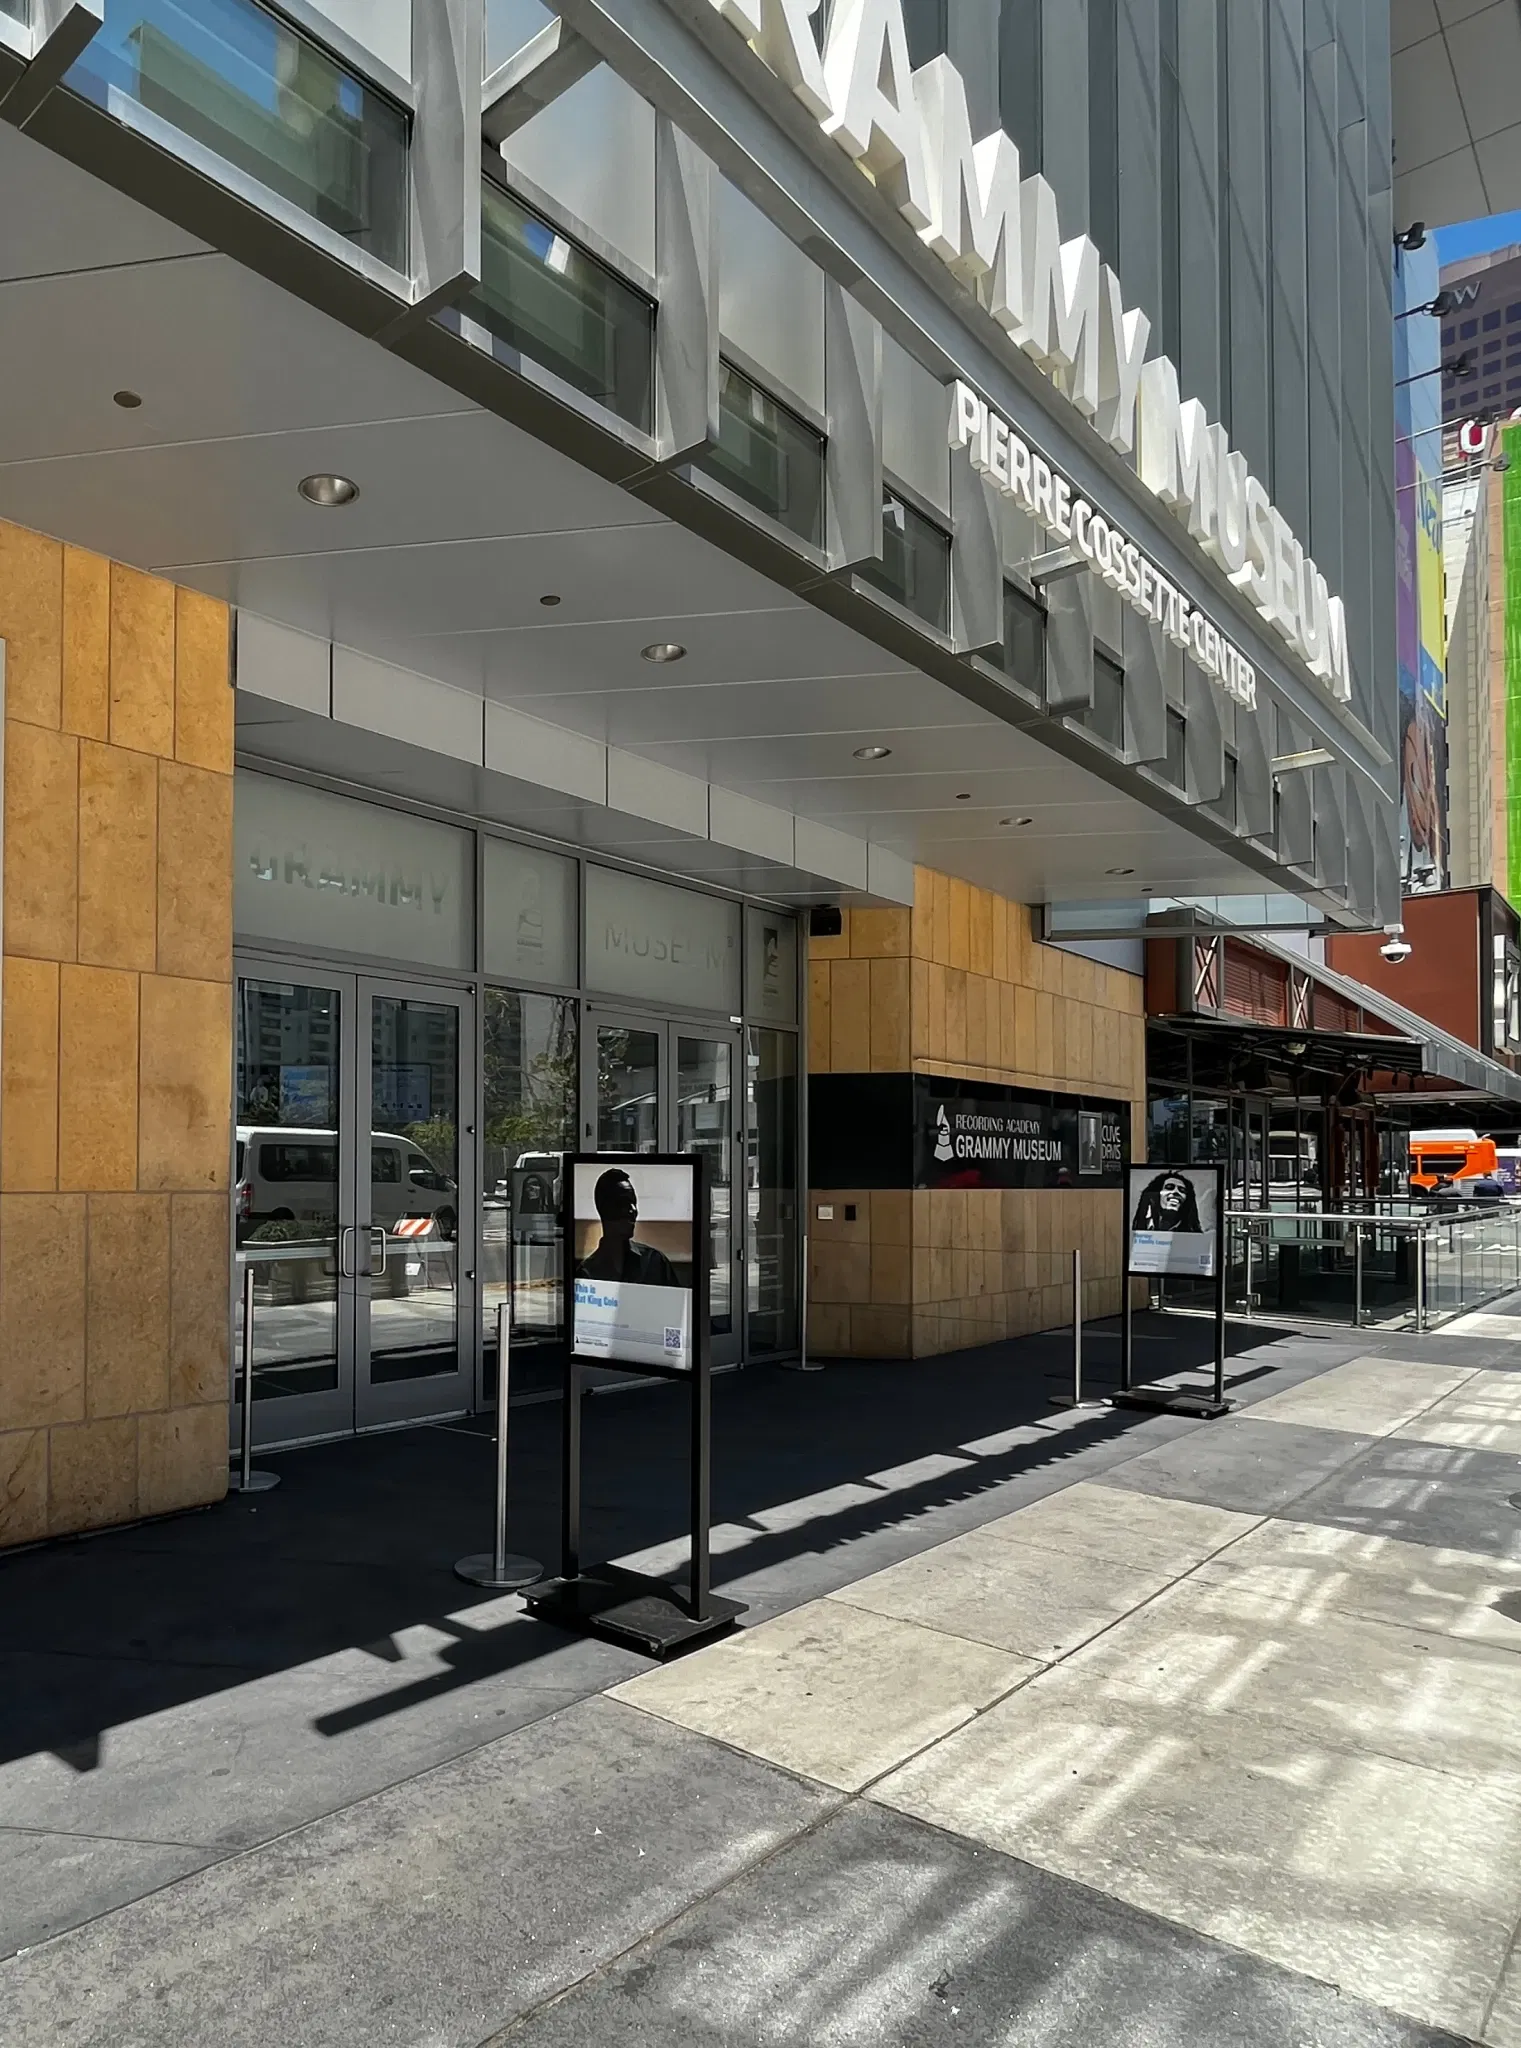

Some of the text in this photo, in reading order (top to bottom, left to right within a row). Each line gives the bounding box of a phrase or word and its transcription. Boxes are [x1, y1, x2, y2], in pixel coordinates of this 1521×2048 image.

[1453, 281, 1481, 304] W
[1139, 355, 1352, 702] MUSEUM
[948, 379, 1258, 711] PIERRE COSSETTE CENTER
[605, 924, 728, 971] MUSEM
[955, 1114, 1041, 1135] RECORDING ACADEMY
[955, 1135, 1062, 1161] GRAMMY MUSEUM
[575, 1283, 596, 1294] This is
[587, 1295, 602, 1307] King
